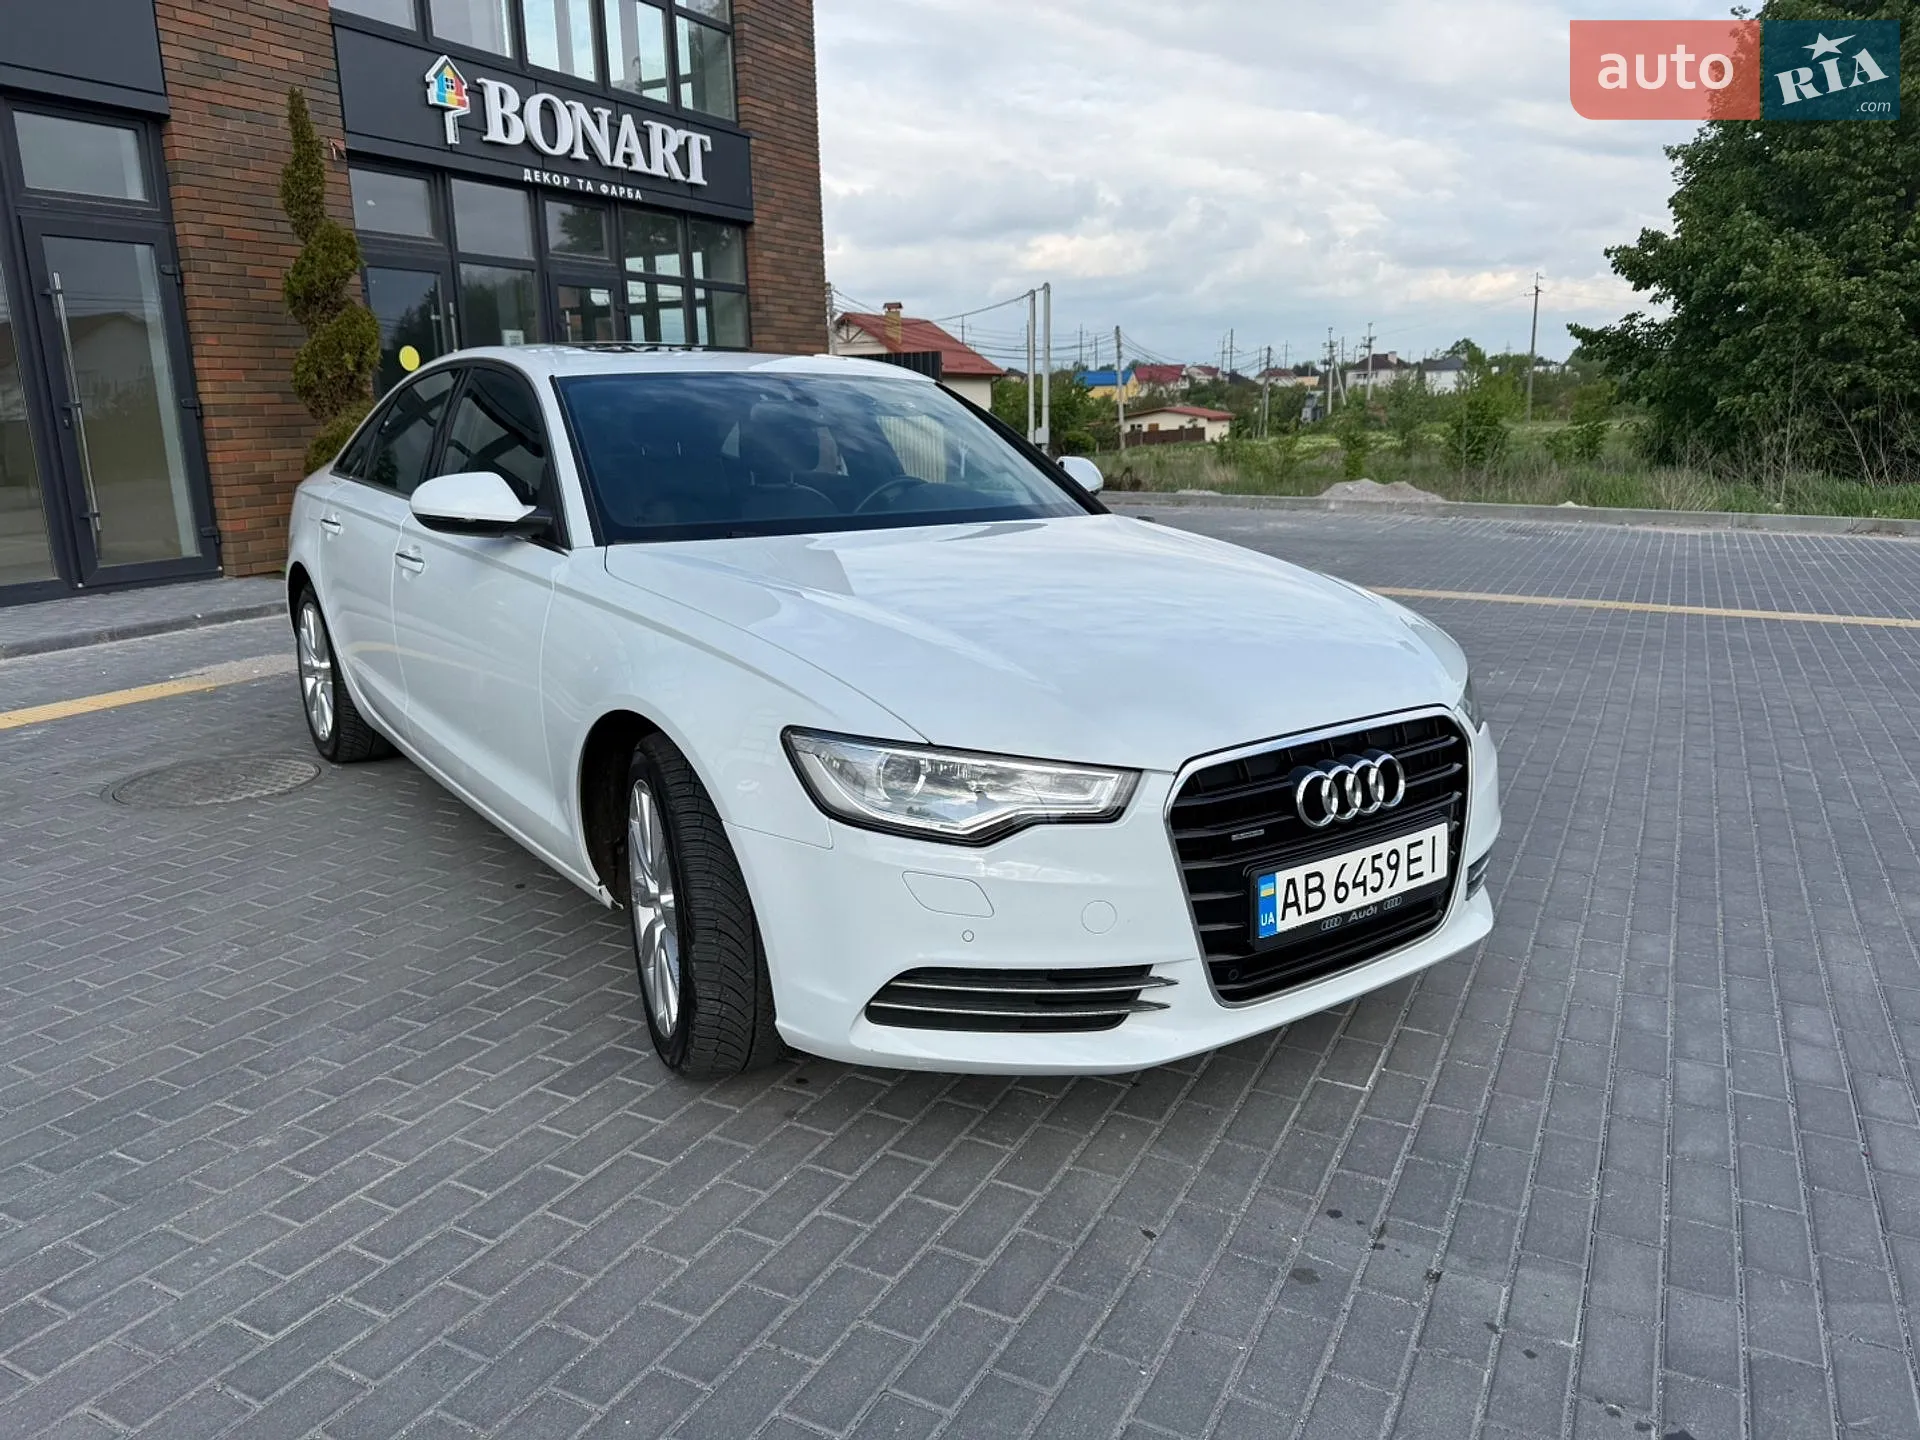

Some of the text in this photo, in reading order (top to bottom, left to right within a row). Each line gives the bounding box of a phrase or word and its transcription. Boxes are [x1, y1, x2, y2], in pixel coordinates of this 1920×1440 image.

[476, 77, 712, 186] BONART
[523, 169, 643, 201] ДЕКОР ТА ФАРБА
[1280, 835, 1436, 921] AB 6459 EI
[1261, 912, 1275, 927] UA
[1348, 905, 1378, 923] Audi
